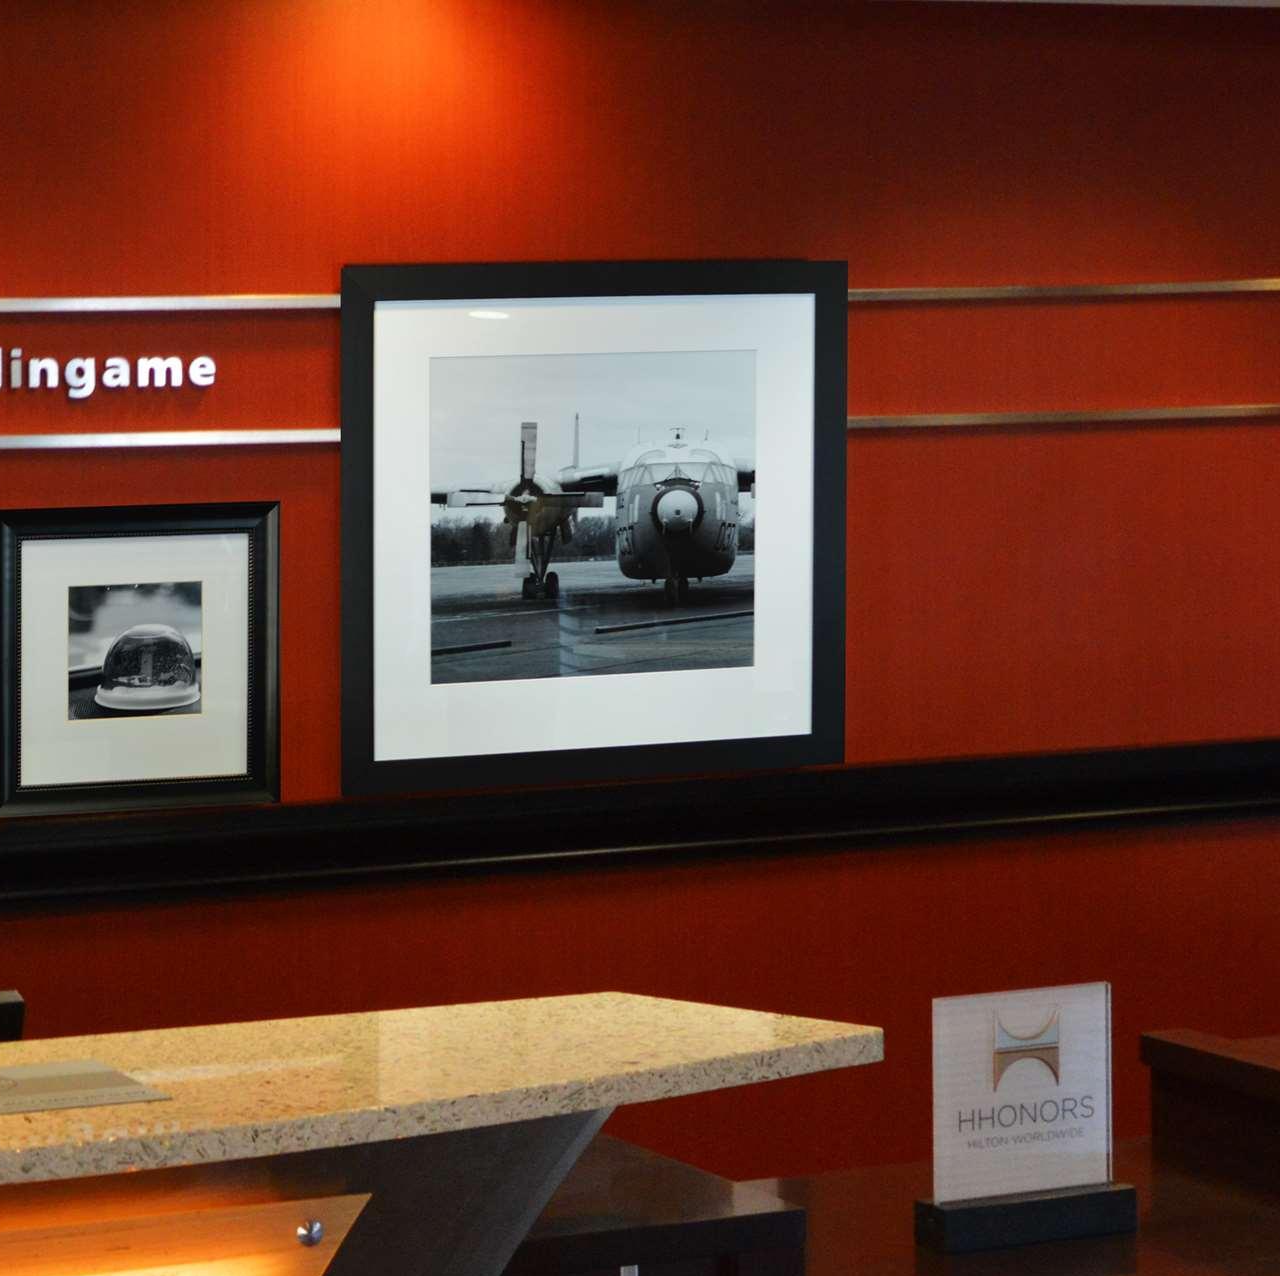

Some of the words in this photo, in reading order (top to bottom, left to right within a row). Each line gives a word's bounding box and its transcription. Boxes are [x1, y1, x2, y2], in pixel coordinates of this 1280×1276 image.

[957, 1095, 1095, 1133] HHONORS
[967, 1136, 1009, 1149] HILTON
[1012, 1128, 1085, 1145] WORLDWIDE
